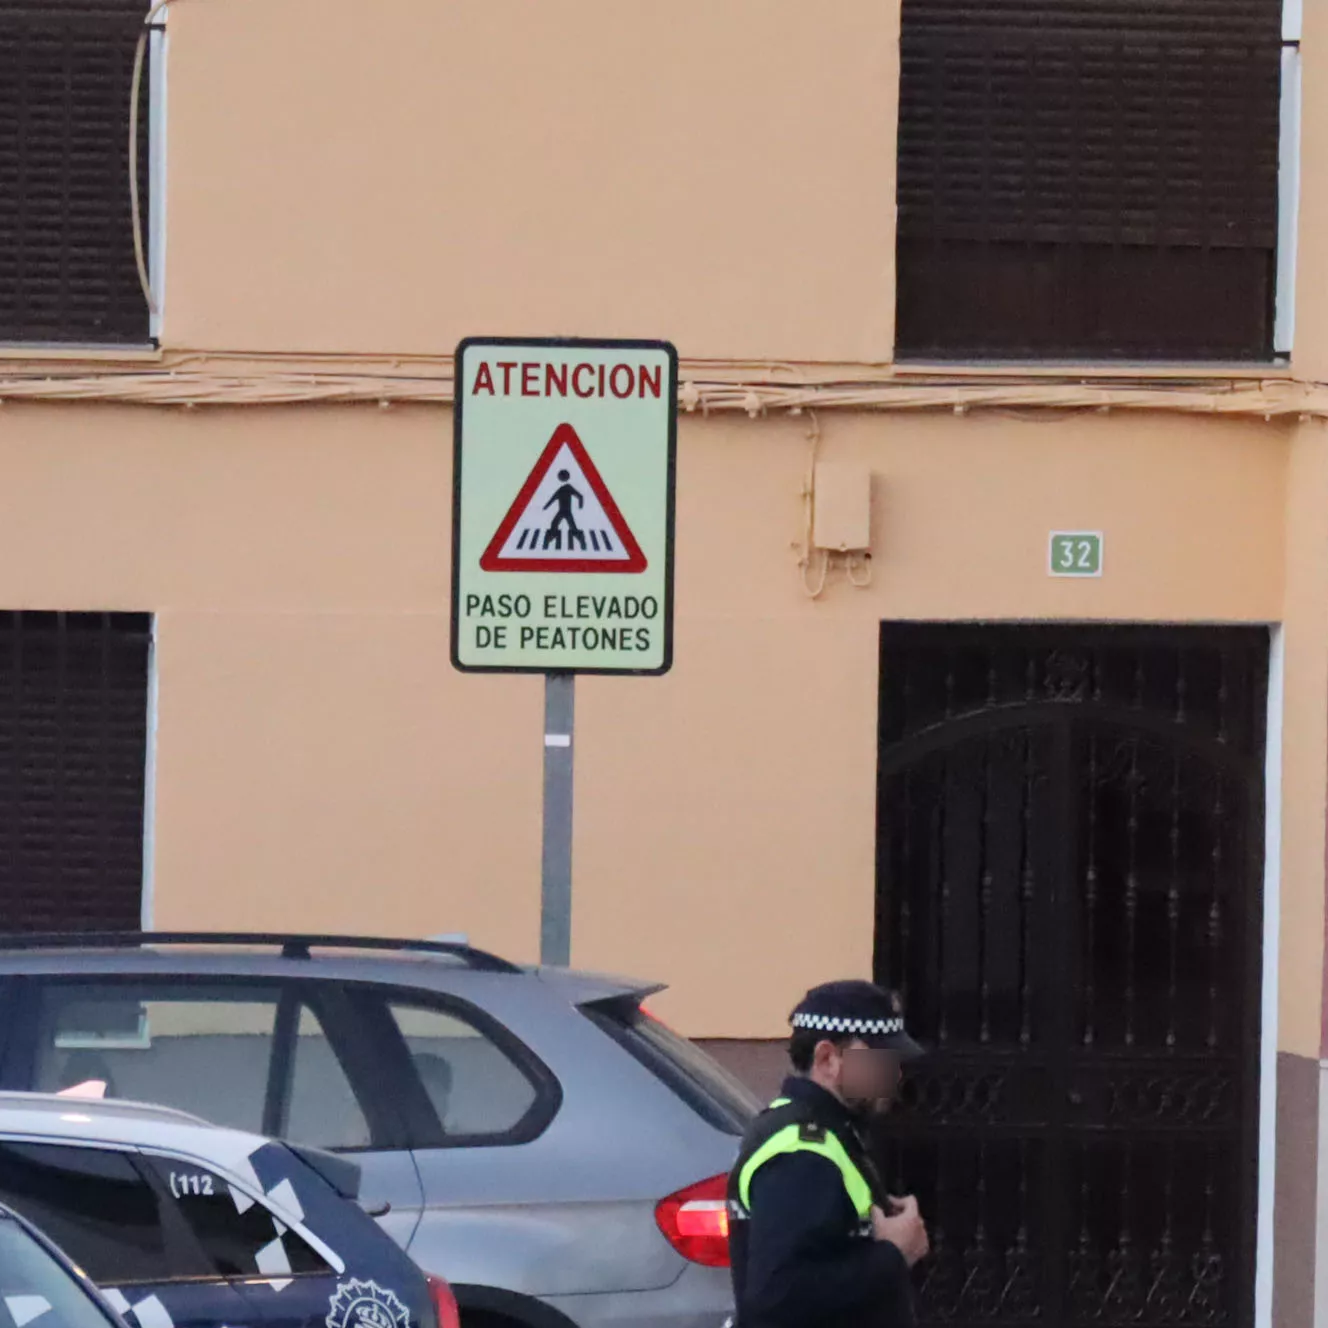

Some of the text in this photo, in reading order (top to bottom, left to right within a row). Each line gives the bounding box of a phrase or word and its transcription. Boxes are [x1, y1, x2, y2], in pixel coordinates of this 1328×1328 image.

[472, 362, 662, 399] ATENCION
[1059, 541, 1091, 567] 32
[465, 594, 658, 619] PASO ELEVADO
[476, 625, 651, 651] DE PEATONES
